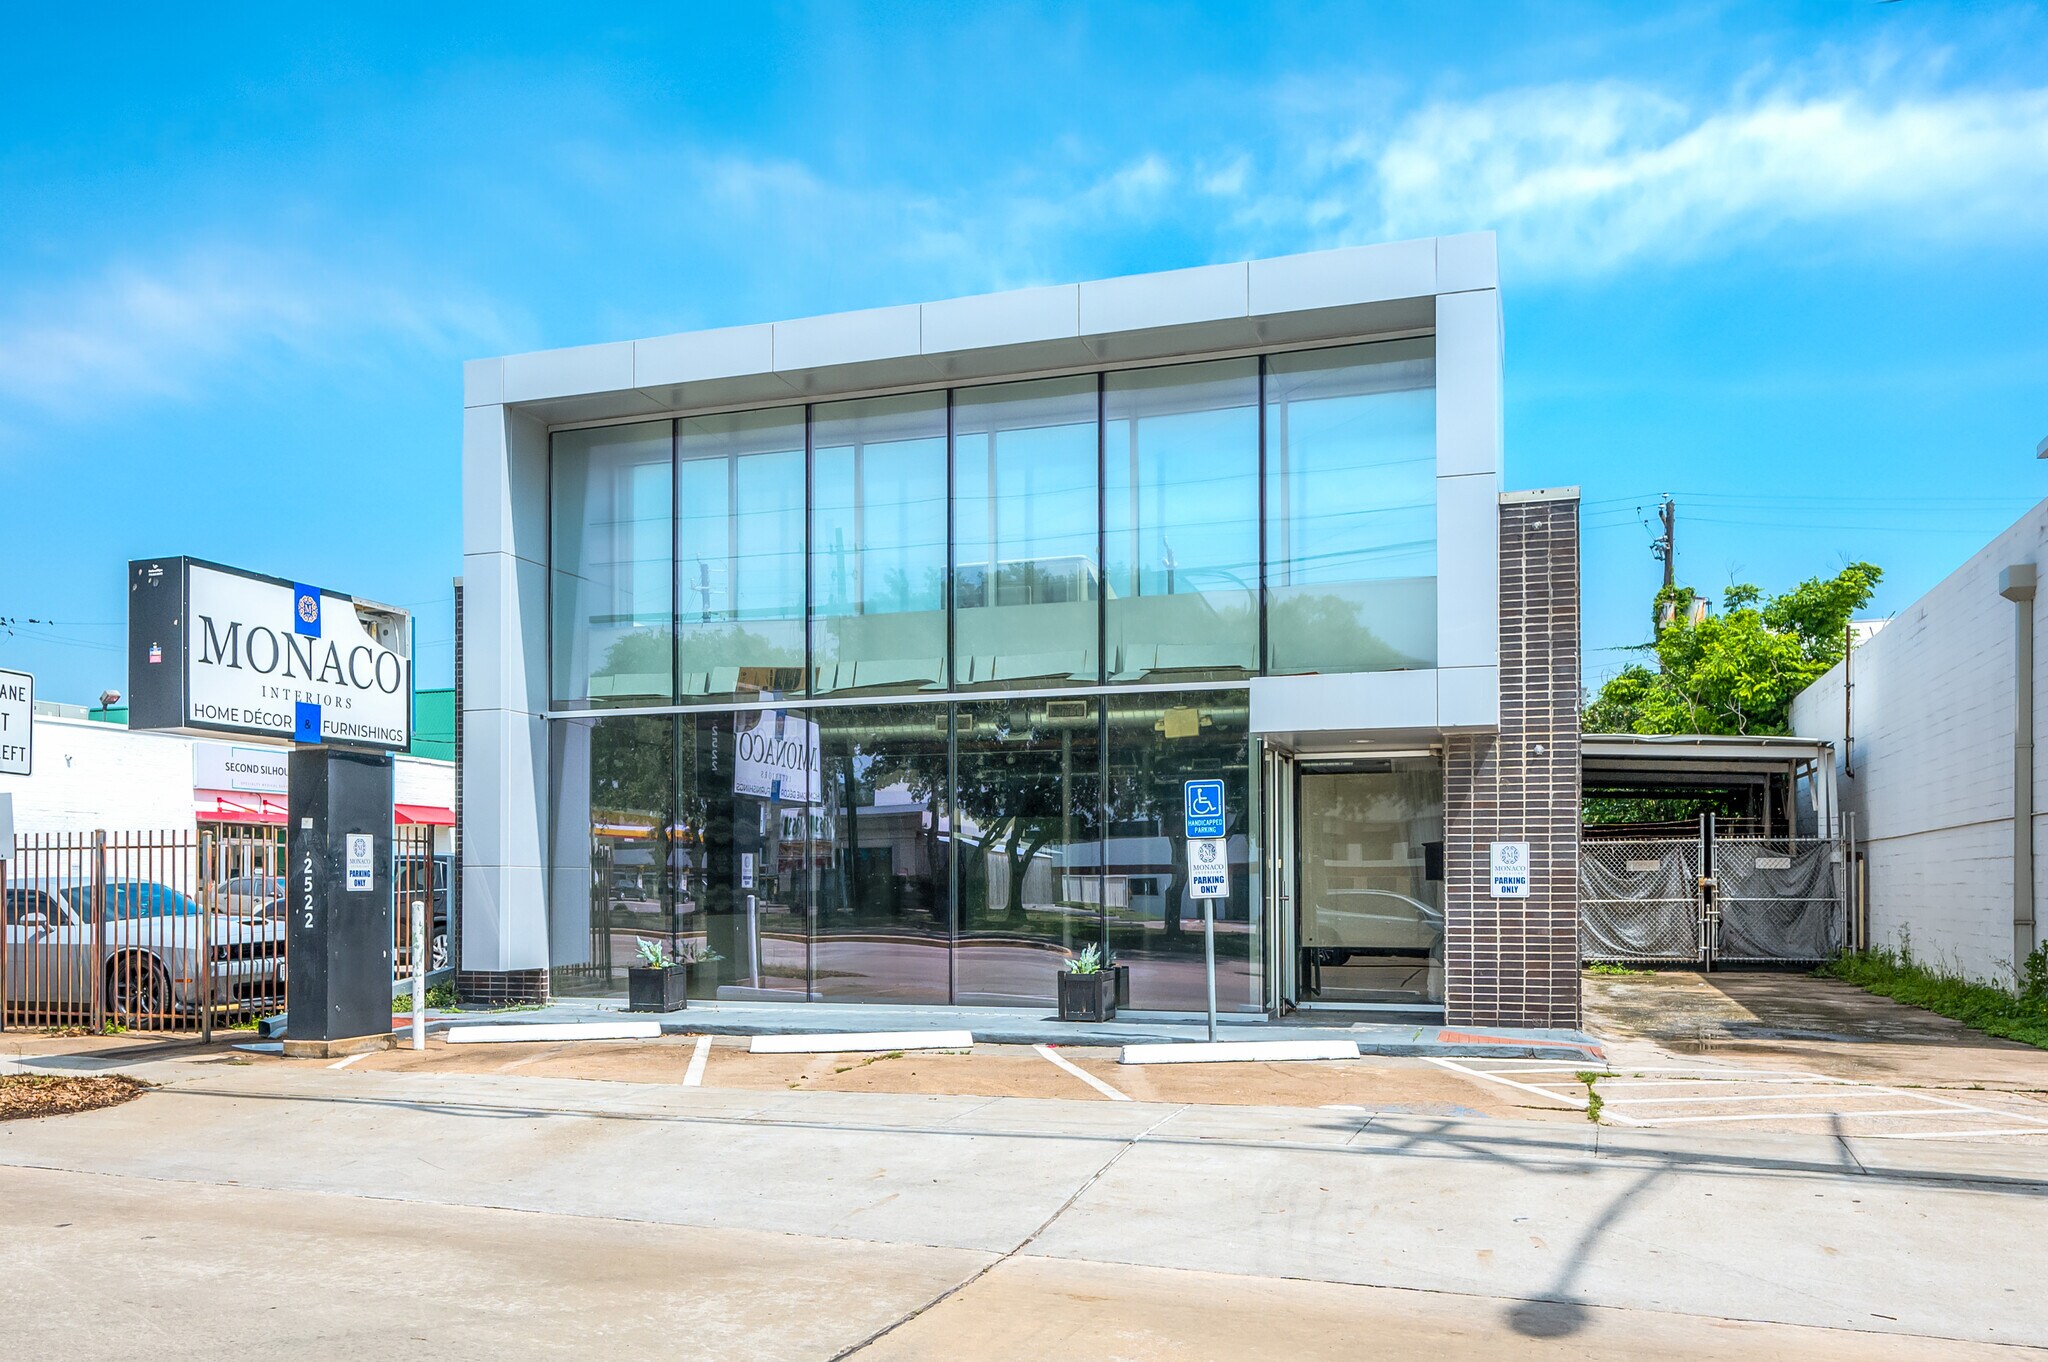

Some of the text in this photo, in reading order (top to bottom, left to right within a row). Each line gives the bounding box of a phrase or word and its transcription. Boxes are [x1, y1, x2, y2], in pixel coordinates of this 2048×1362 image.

[198, 614, 401, 694] MONACO
[0, 683, 26, 702] ANE
[262, 685, 352, 709] INTERIORS
[194, 702, 403, 742] HOME DÉCOR & FURNISHINGS
[0, 744, 26, 762] EFT
[225, 762, 259, 773] SECOND
[1194, 876, 1224, 884] PARKING
[1201, 885, 1218, 894] ONLY
[303, 857, 314, 928] 2522
